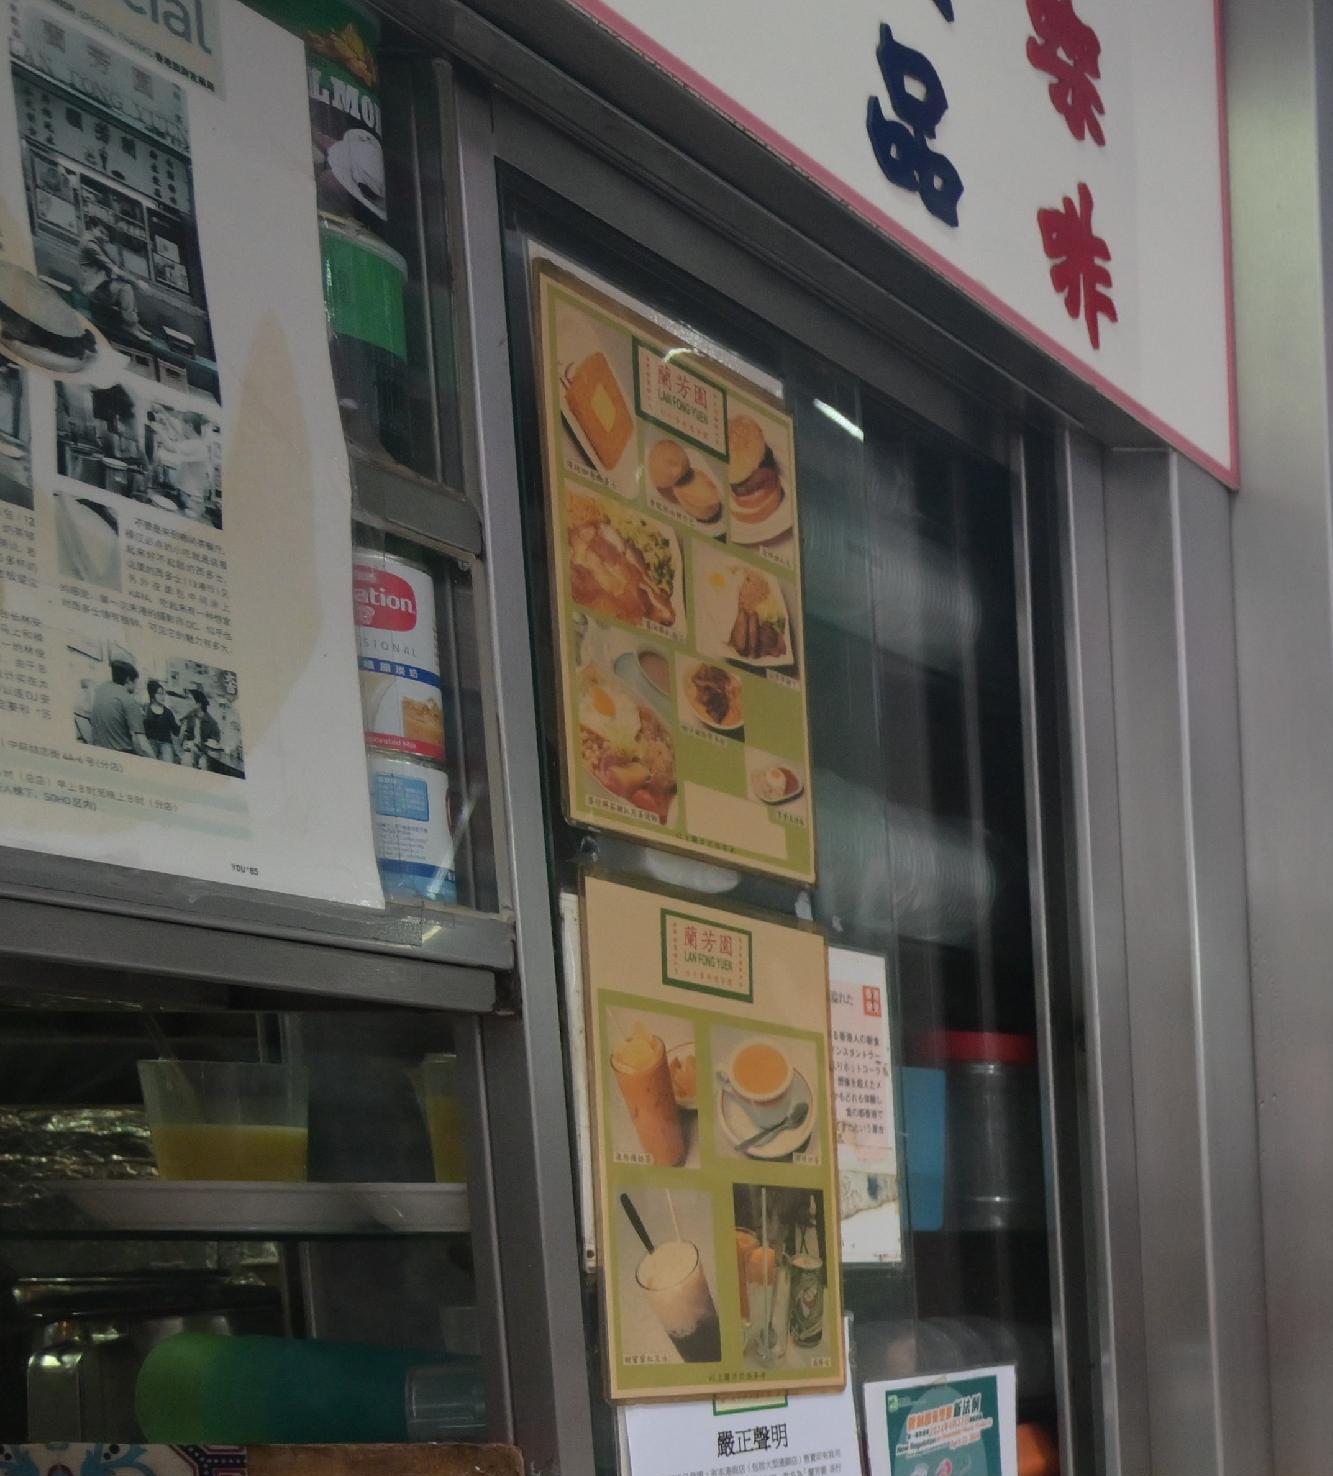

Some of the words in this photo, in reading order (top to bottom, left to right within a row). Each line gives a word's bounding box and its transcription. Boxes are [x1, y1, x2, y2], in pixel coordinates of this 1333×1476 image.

[684, 925, 733, 957] 蘭芳園
[684, 951, 697, 963] LAN
[698, 953, 715, 969] FONG
[717, 957, 733, 971] YUEN
[717, 1423, 789, 1458] 嚴正聲明
